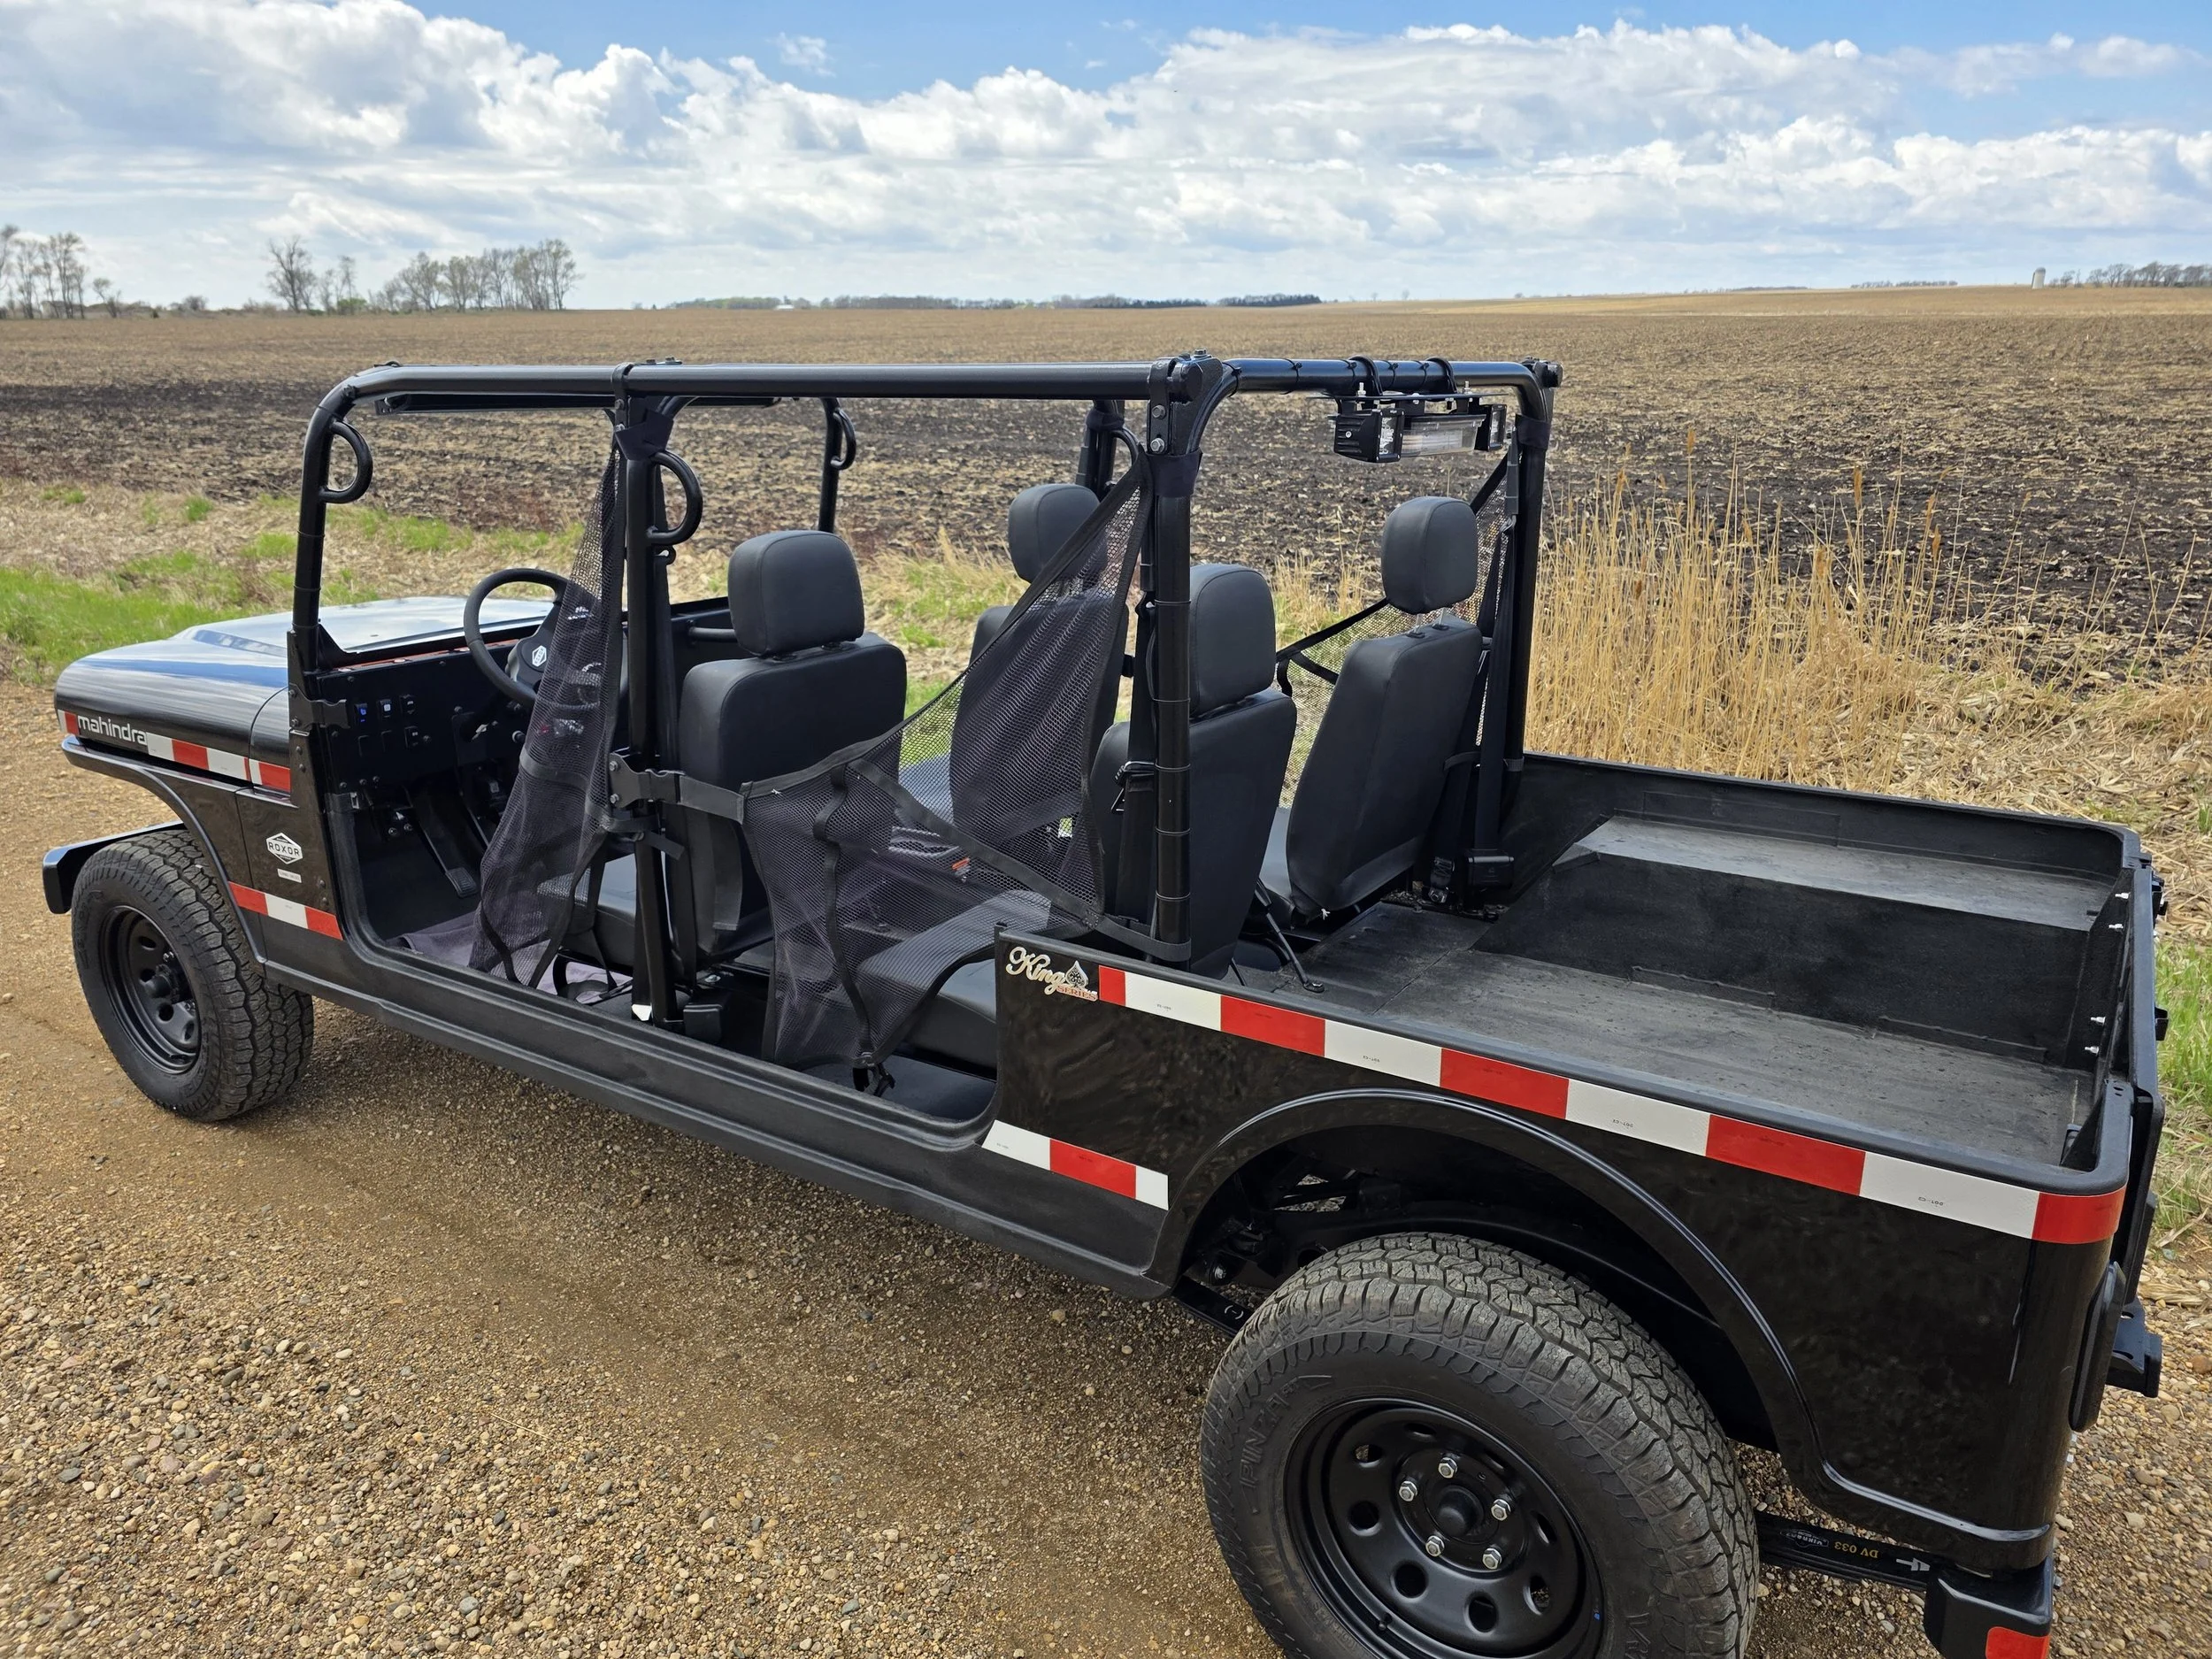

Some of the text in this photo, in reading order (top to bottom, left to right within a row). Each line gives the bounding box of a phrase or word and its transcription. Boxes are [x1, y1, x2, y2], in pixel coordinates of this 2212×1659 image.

[78, 715, 149, 746] mahindra
[268, 841, 300, 856] ROXOR
[1005, 946, 1067, 995] King
[1056, 985, 1096, 1000] SERIES
[1834, 1541, 1879, 1559] DV 033
